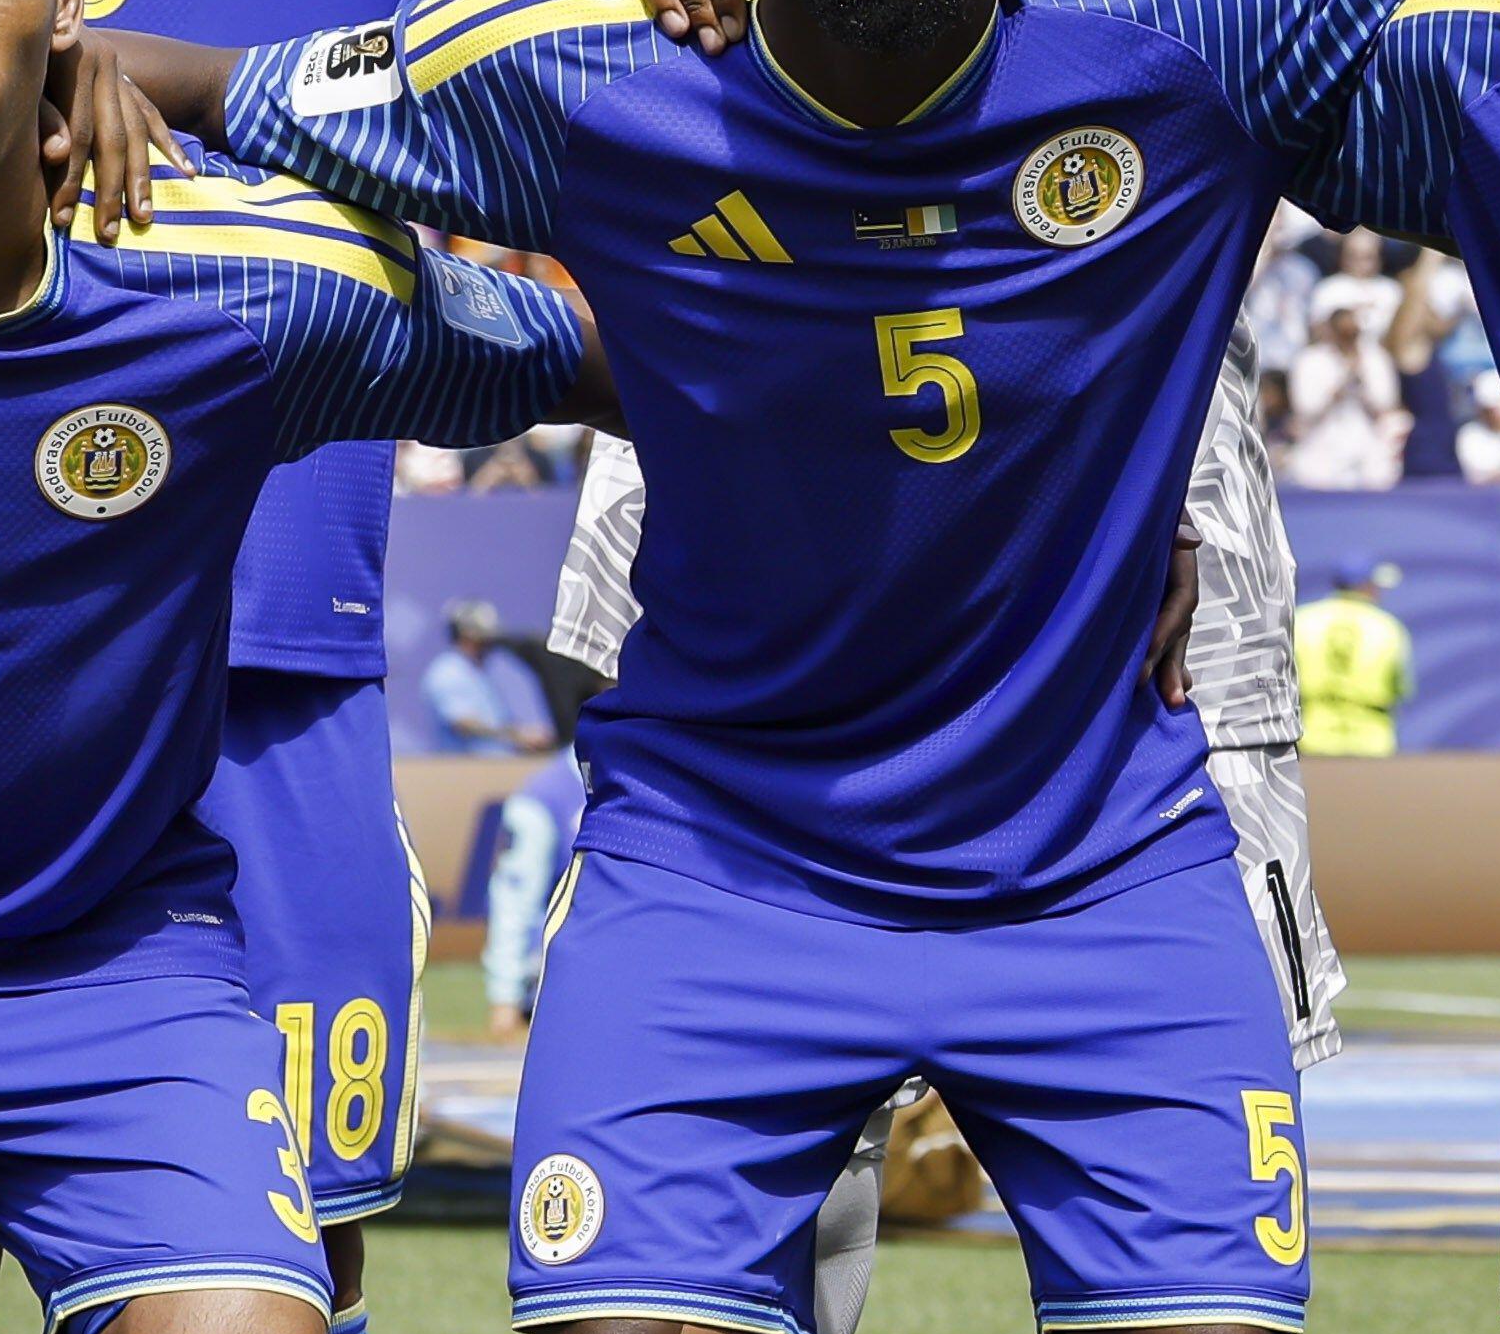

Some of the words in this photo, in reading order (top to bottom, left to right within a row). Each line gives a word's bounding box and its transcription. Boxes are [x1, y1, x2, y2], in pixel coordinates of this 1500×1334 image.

[1022, 147, 1060, 241] Federashon
[45, 416, 89, 506] Federashon
[873, 307, 983, 465] 5
[1265, 859, 1312, 1021] 1
[274, 997, 389, 1161] 18
[245, 1088, 319, 1245] 3
[1240, 1089, 1308, 1267] 5
